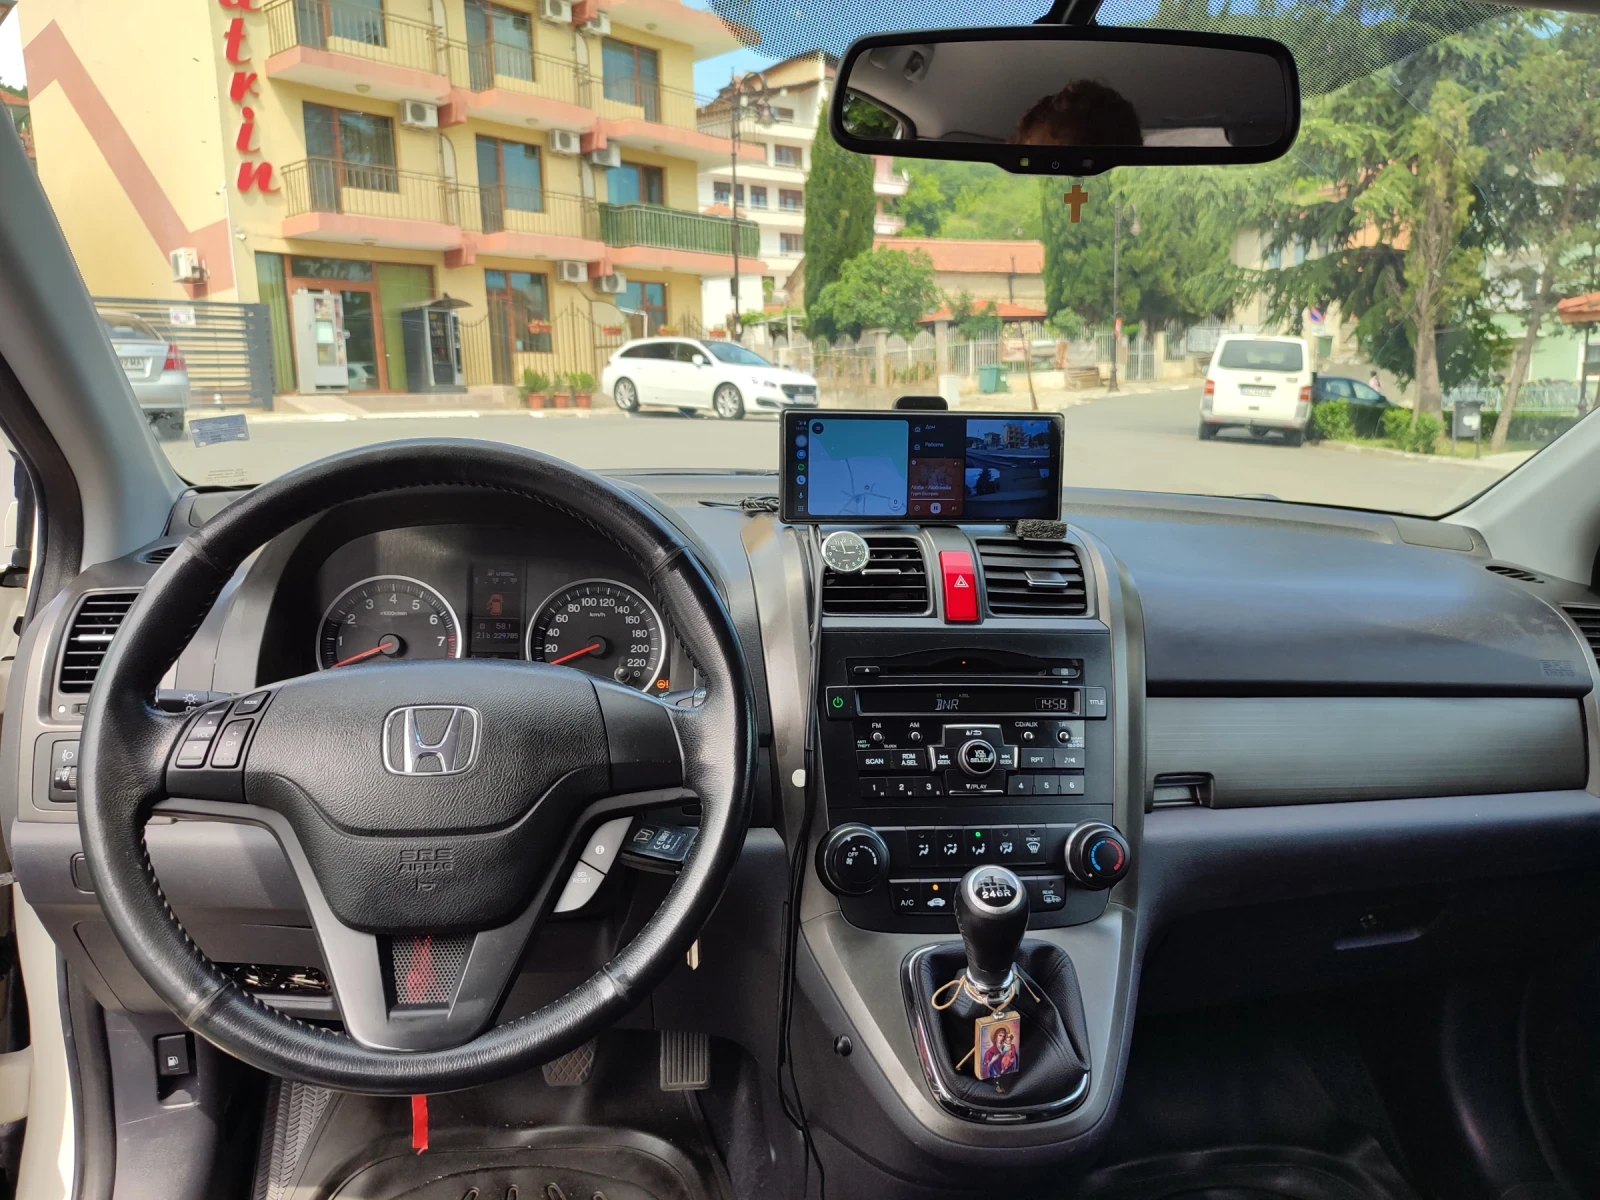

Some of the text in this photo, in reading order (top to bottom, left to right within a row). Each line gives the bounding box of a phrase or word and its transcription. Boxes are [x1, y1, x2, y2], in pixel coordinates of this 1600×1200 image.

[390, 594, 397, 604] 4
[581, 598, 597, 606] 100
[600, 598, 615, 607] 120
[366, 599, 374, 610] 3
[412, 600, 420, 610] 5
[568, 604, 580, 612] 80
[614, 606, 630, 614] 140
[348, 614, 356, 624] 2
[430, 614, 438, 625] 6
[556, 614, 568, 622] 60
[625, 616, 640, 624] 160
[547, 628, 560, 637] 40
[632, 629, 648, 638] 180
[338, 636, 343, 646] 1
[437, 636, 445, 646] 7
[545, 644, 558, 653] 20
[630, 644, 650, 653] 200
[627, 658, 646, 667] 220
[1041, 700, 1067, 709] 14:58
[400, 848, 454, 860] SRS
[400, 862, 454, 872] AIRBAG
